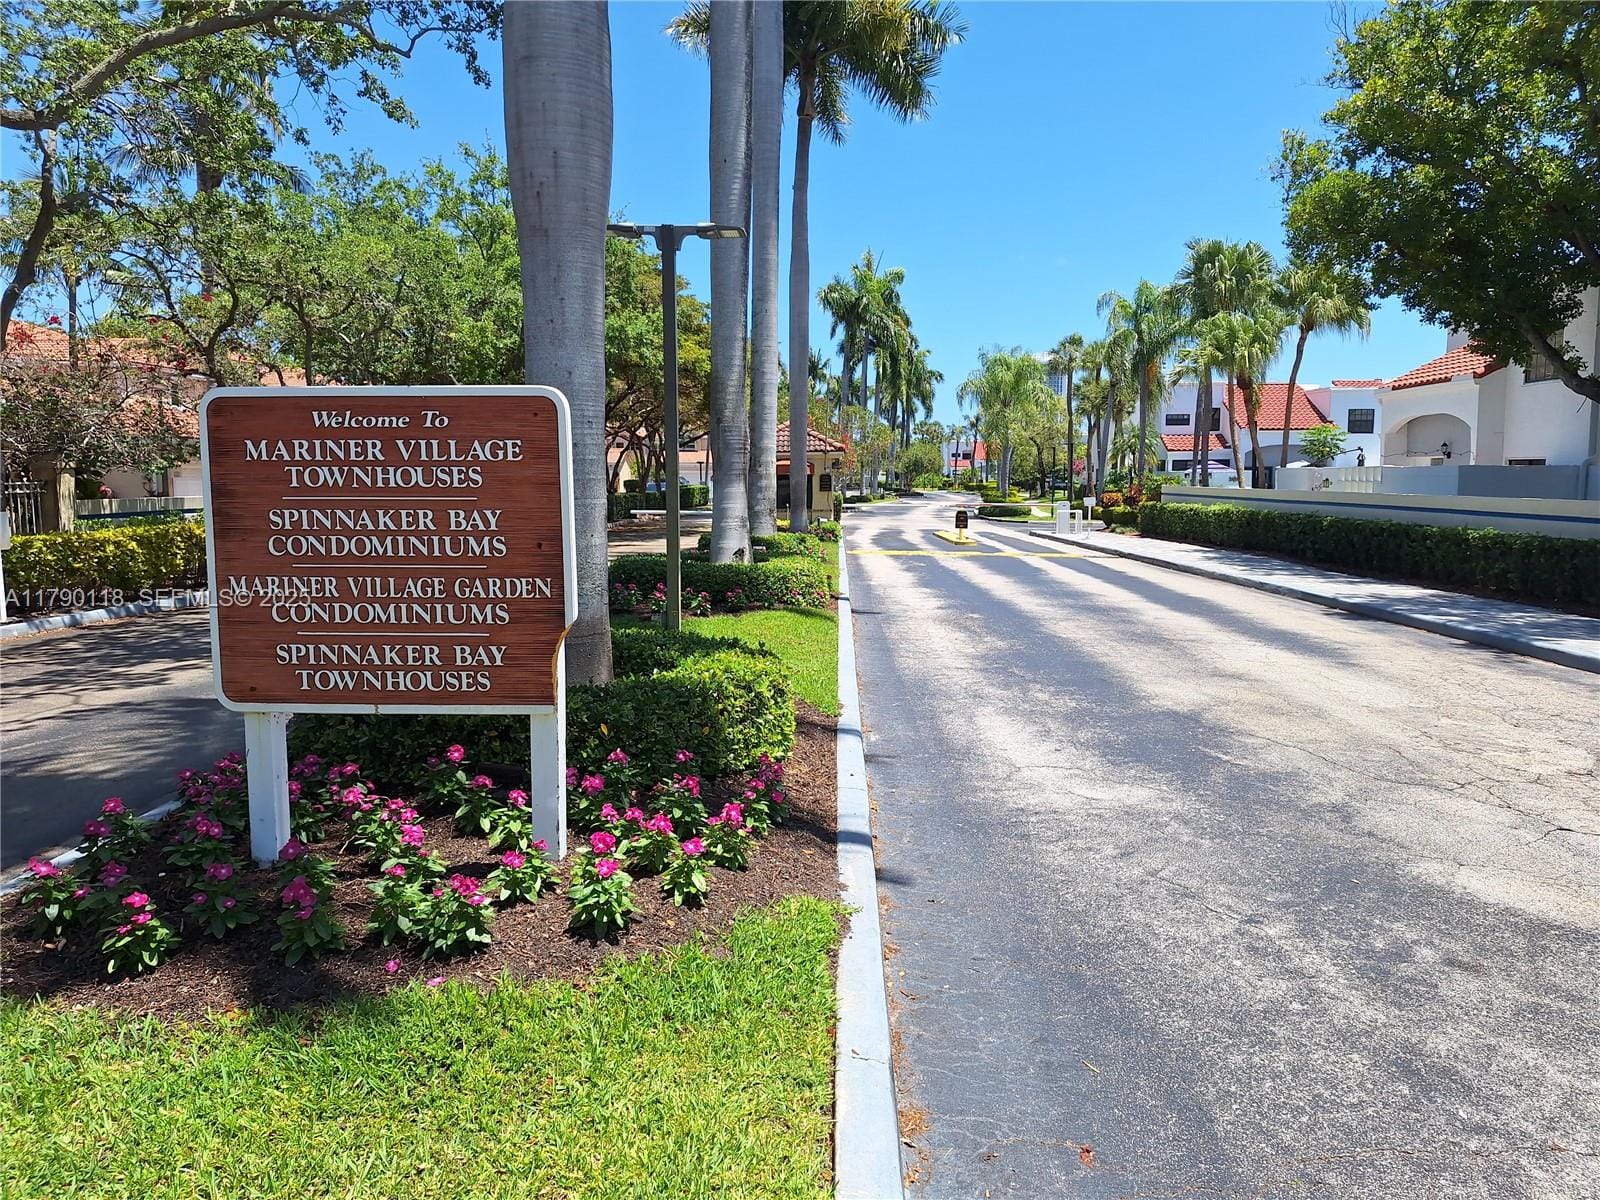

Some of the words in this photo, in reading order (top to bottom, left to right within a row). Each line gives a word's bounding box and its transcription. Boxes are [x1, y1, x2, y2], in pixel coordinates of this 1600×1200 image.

[312, 410, 410, 429] Welcome
[422, 411, 449, 429] To
[244, 439, 385, 462] MARINER
[395, 440, 523, 462] VILLAGE
[284, 466, 483, 489] TOWNHOUSES
[268, 509, 436, 531] SPINNAKER
[449, 509, 502, 532] BAY
[267, 535, 508, 557] CONDOMINIUMS
[228, 576, 340, 598] MARINER
[347, 576, 449, 599] VILLAGE
[454, 577, 552, 599] GARDEN
[271, 602, 510, 625] CONDOMINIUMS
[276, 643, 442, 667] SPINNAKER
[453, 645, 508, 667] BAY
[296, 669, 492, 692] TOWNHOUSES
